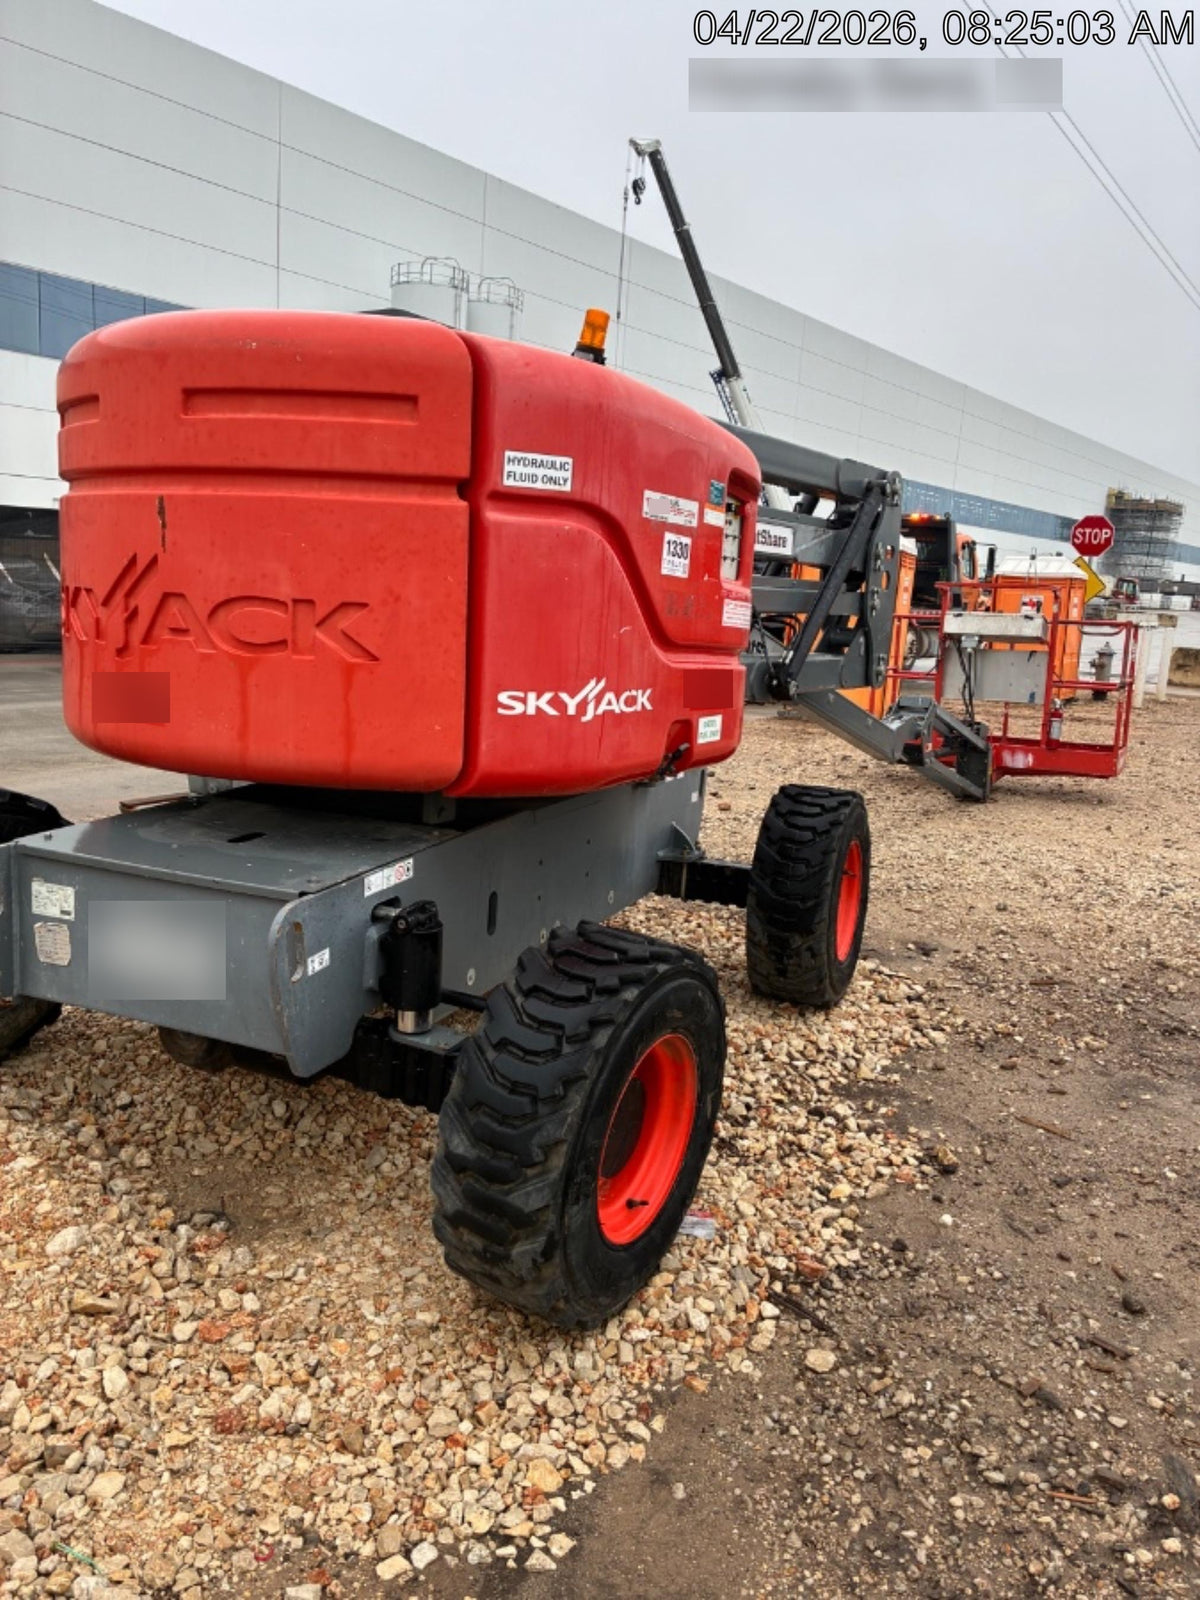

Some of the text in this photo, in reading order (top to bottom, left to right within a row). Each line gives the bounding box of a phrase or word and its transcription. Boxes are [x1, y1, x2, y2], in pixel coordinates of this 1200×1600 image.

[507, 455, 570, 472] HYDRAULIC
[506, 470, 569, 487] FLUID ONLY
[1074, 528, 1112, 545] STOP
[62, 552, 380, 663] KYJACK
[497, 677, 653, 723] SKYJACK
